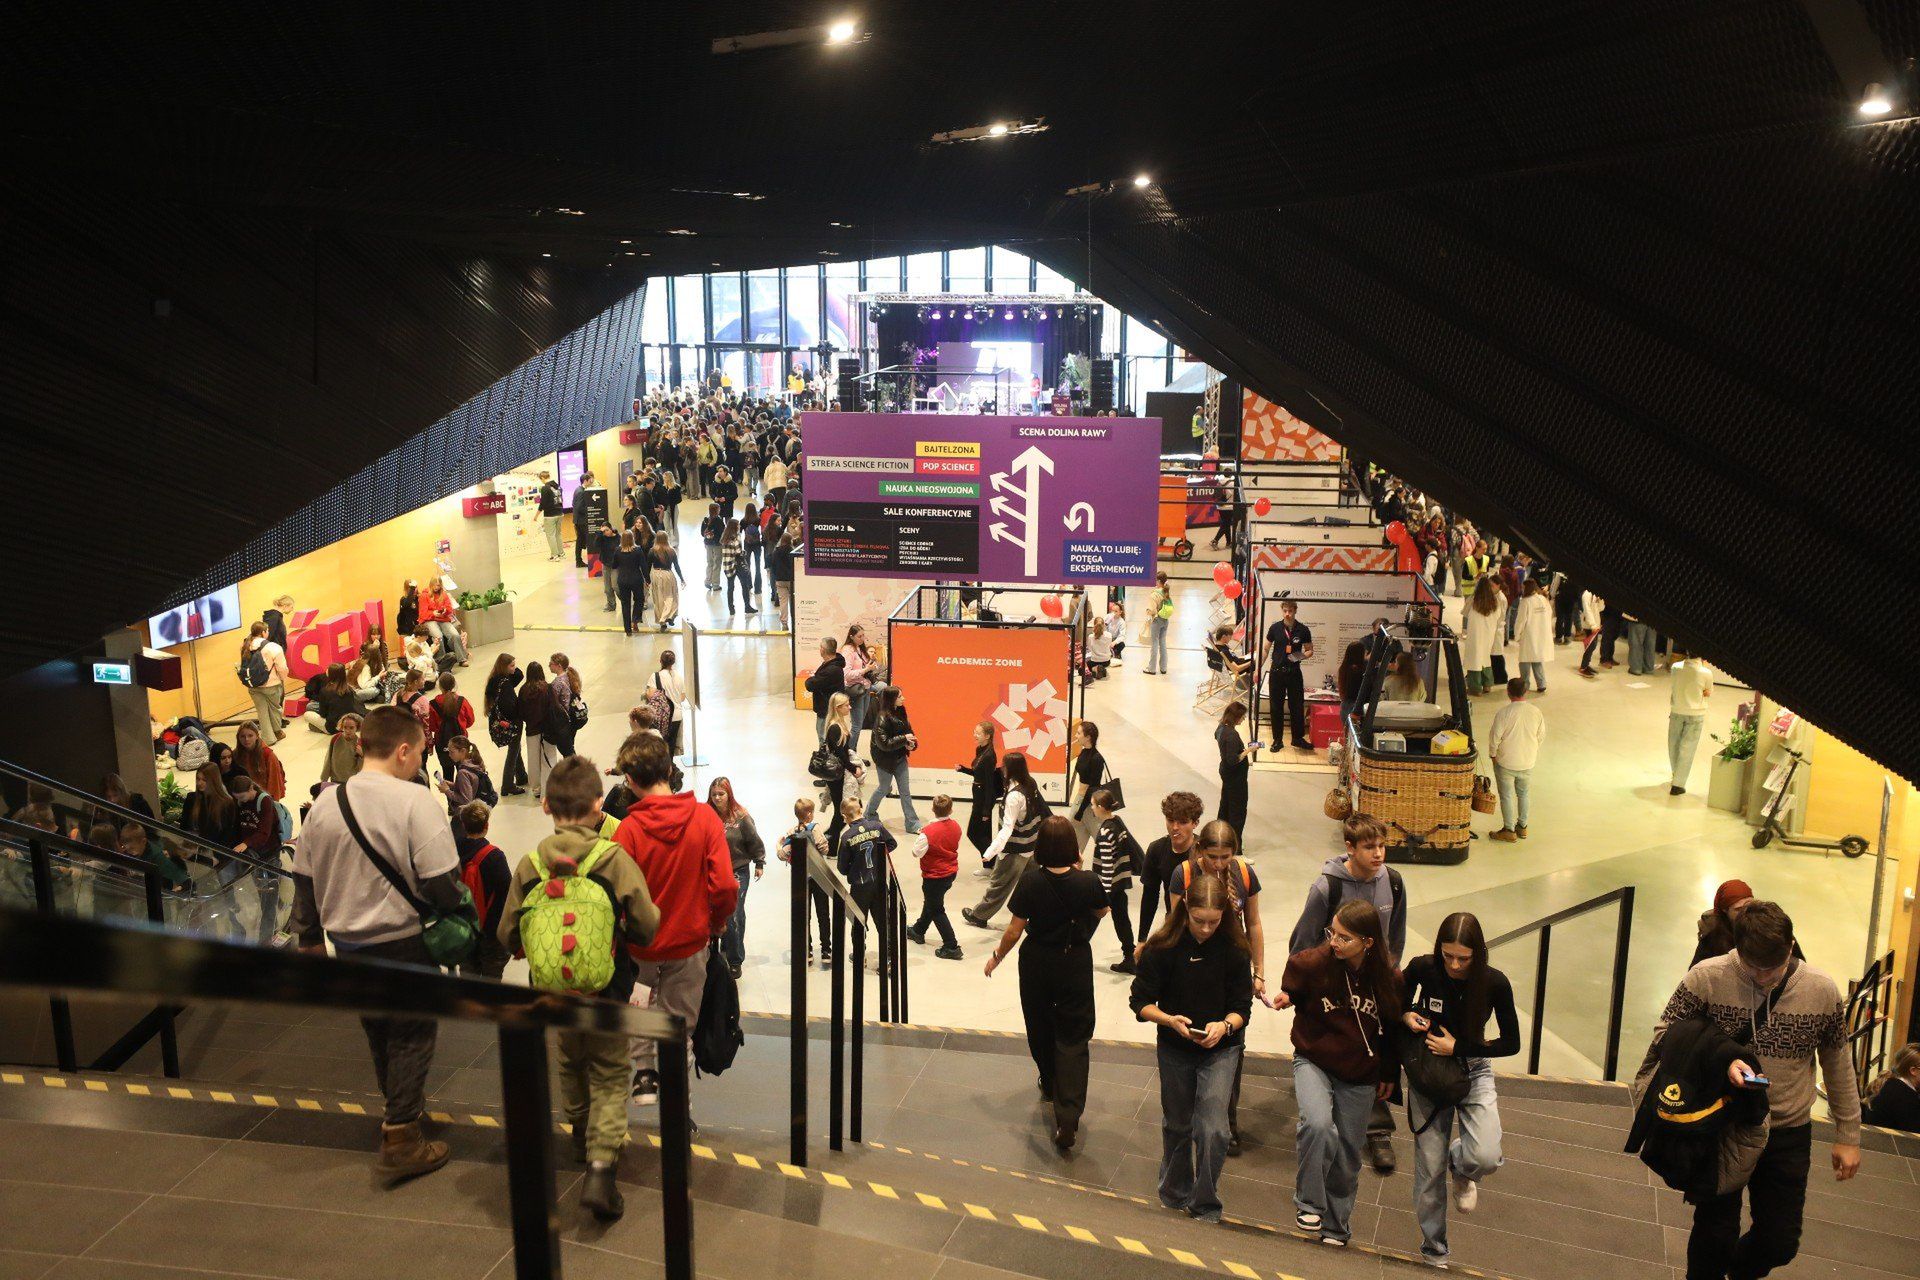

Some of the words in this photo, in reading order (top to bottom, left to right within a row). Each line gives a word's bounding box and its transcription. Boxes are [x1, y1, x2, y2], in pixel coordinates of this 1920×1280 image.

[1019, 427, 1046, 436] SCENA
[1048, 428, 1080, 437] DOLINA
[1081, 429, 1107, 437] RAWY
[924, 445, 975, 454] BAJTELZONA
[811, 459, 841, 468] STREFA
[843, 460, 875, 469] SCIENCE
[877, 461, 909, 470] FICTION
[922, 462, 939, 471] POP
[941, 462, 975, 472] SCIENCE
[885, 484, 914, 493] NAUKA
[915, 485, 974, 495] NIEOSWOJONA
[490, 500, 505, 509] ABC
[883, 507, 903, 516] SALE
[905, 508, 972, 518] KONFERENCYJNE
[1115, 546, 1142, 555] LUBIĘ:
[1070, 555, 1103, 564] POTĘGA
[1070, 564, 1144, 574] EKSPERYMENTÓW
[1295, 590, 1347, 599] UNIWERSYTET
[1349, 589, 1375, 599] ŚLĄSKI
[937, 656, 993, 666] ACADEMIC
[995, 658, 1022, 667] ZONE
[860, 840, 874, 868] 7
